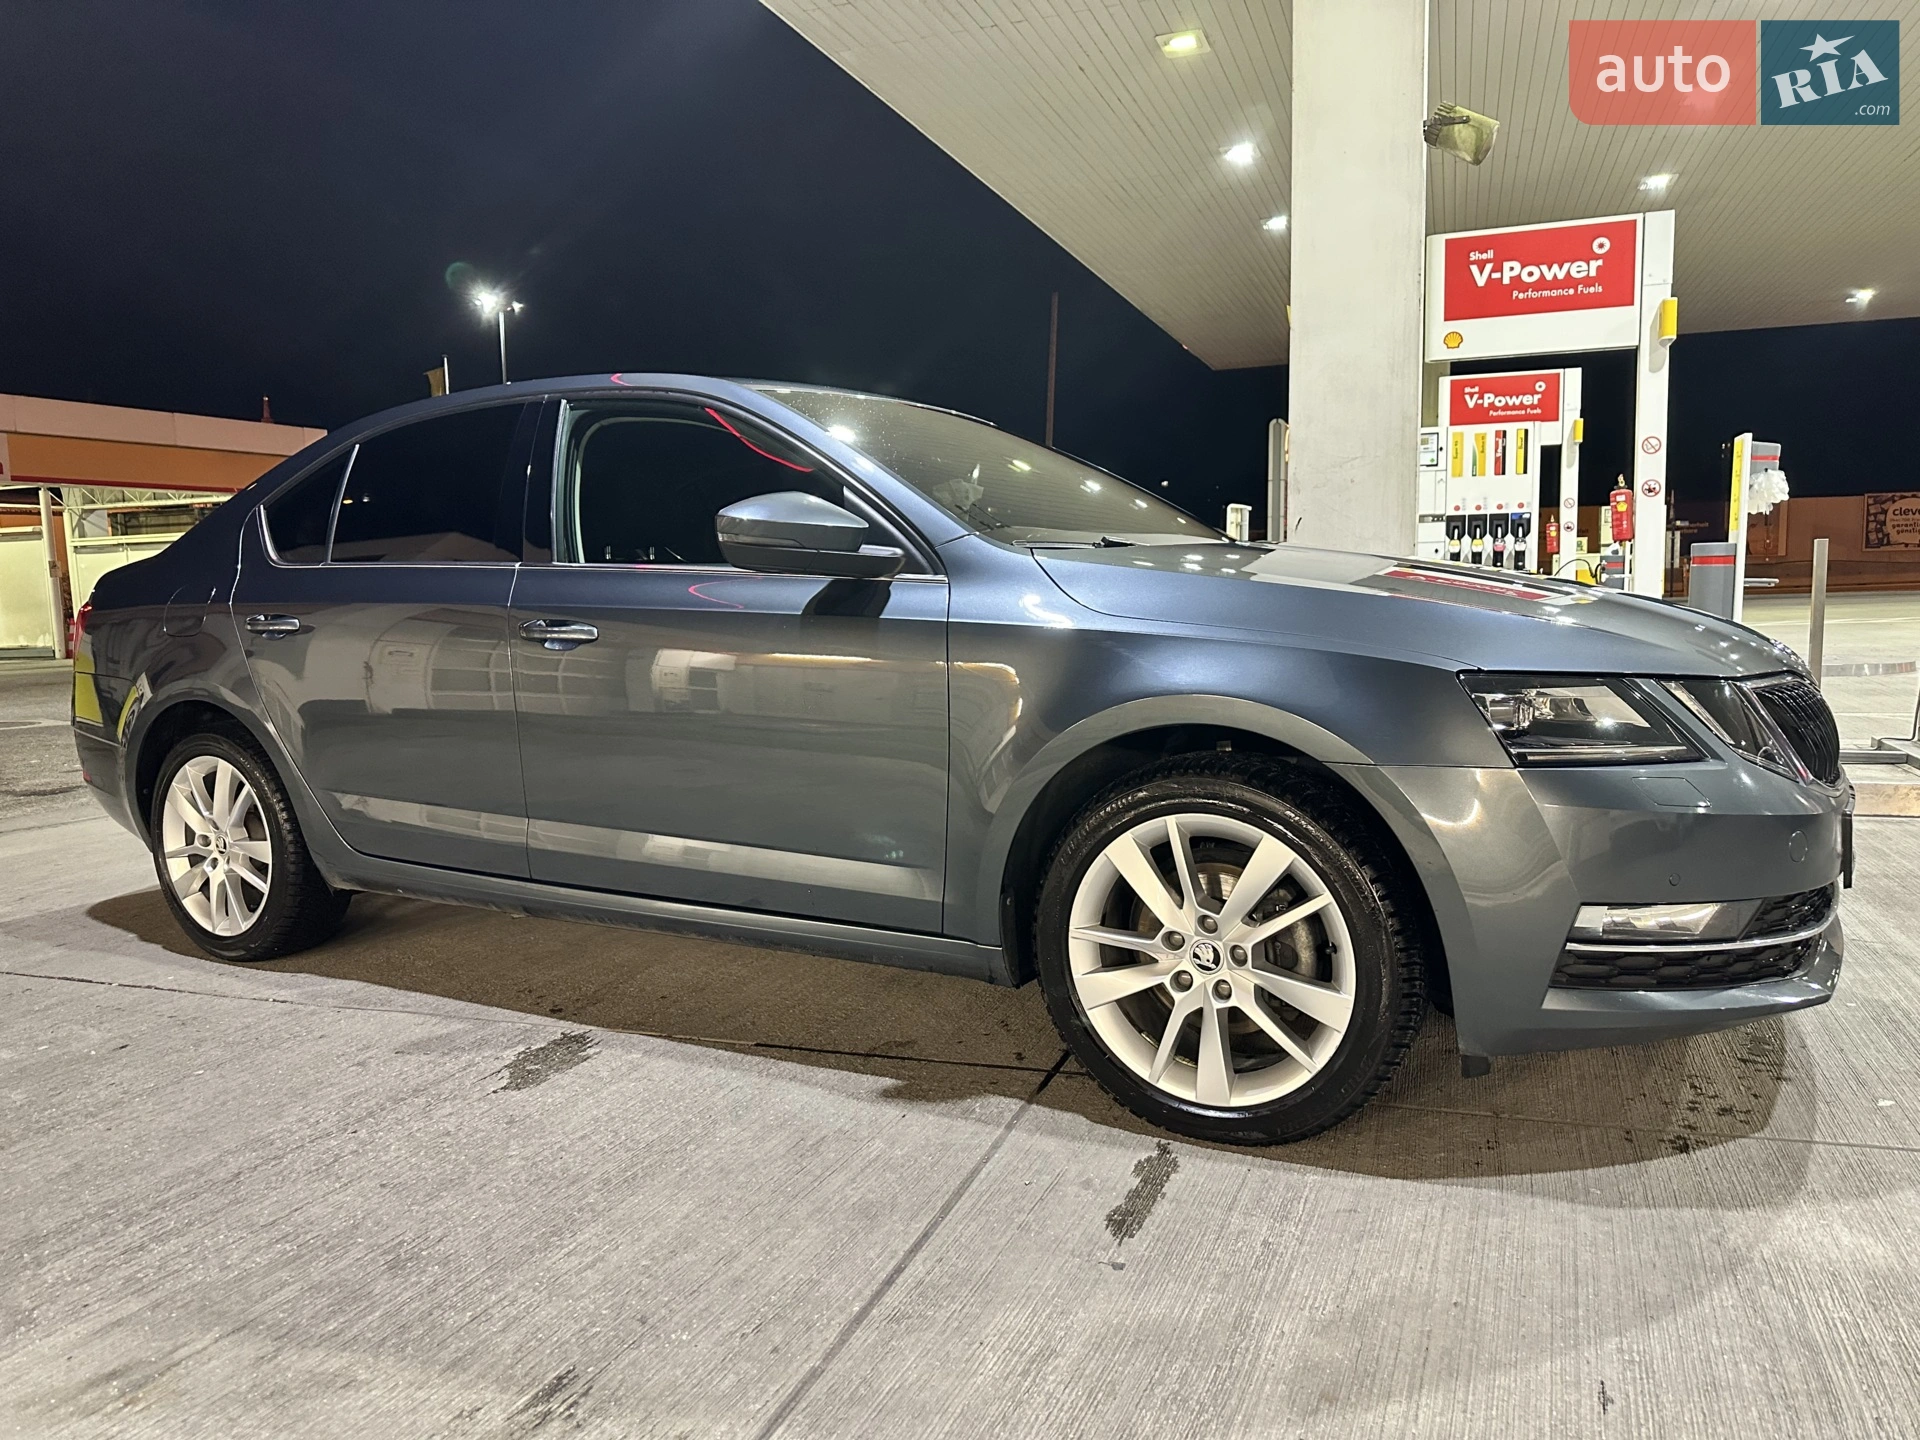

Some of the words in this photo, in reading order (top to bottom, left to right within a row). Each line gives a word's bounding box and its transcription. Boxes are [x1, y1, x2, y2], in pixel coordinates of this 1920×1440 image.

[1469, 249, 1494, 261] Shell
[1469, 259, 1603, 287] V-Power
[1512, 287, 1574, 300] Performance
[1578, 283, 1603, 294] Fuels
[1464, 393, 1542, 408] V-Power
[1489, 408, 1525, 416] Performance
[1893, 507, 1920, 516] clev
